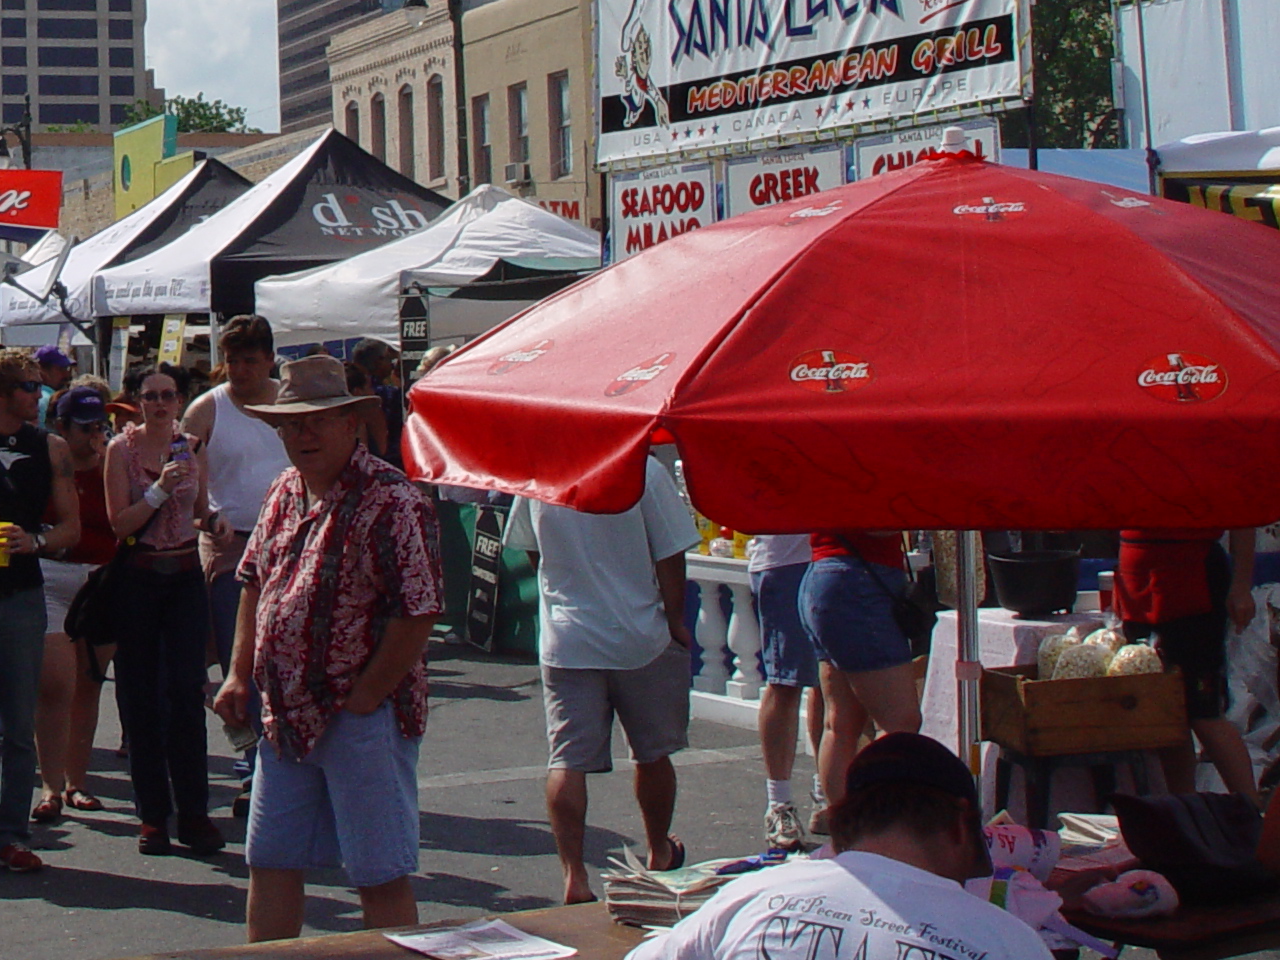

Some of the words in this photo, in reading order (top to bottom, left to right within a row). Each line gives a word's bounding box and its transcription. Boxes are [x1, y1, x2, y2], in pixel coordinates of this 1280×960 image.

[686, 44, 899, 115] MEDITERRANEAN
[911, 24, 1002, 73] GRILL
[632, 133, 662, 147] USA
[732, 109, 803, 132] CANADA
[622, 182, 704, 218] SEAFOOD
[749, 166, 819, 206] GREEK
[539, 200, 580, 220] ATM
[403, 321, 427, 337] FREE
[790, 362, 870, 382] Coca-Cola
[1137, 364, 1221, 388] Coca-Cola
[475, 535, 499, 558] FREE
[767, 894, 804, 912] Old
[800, 895, 853, 922] Pecan
[859, 908, 912, 935] Street
[917, 921, 989, 960] Festival
